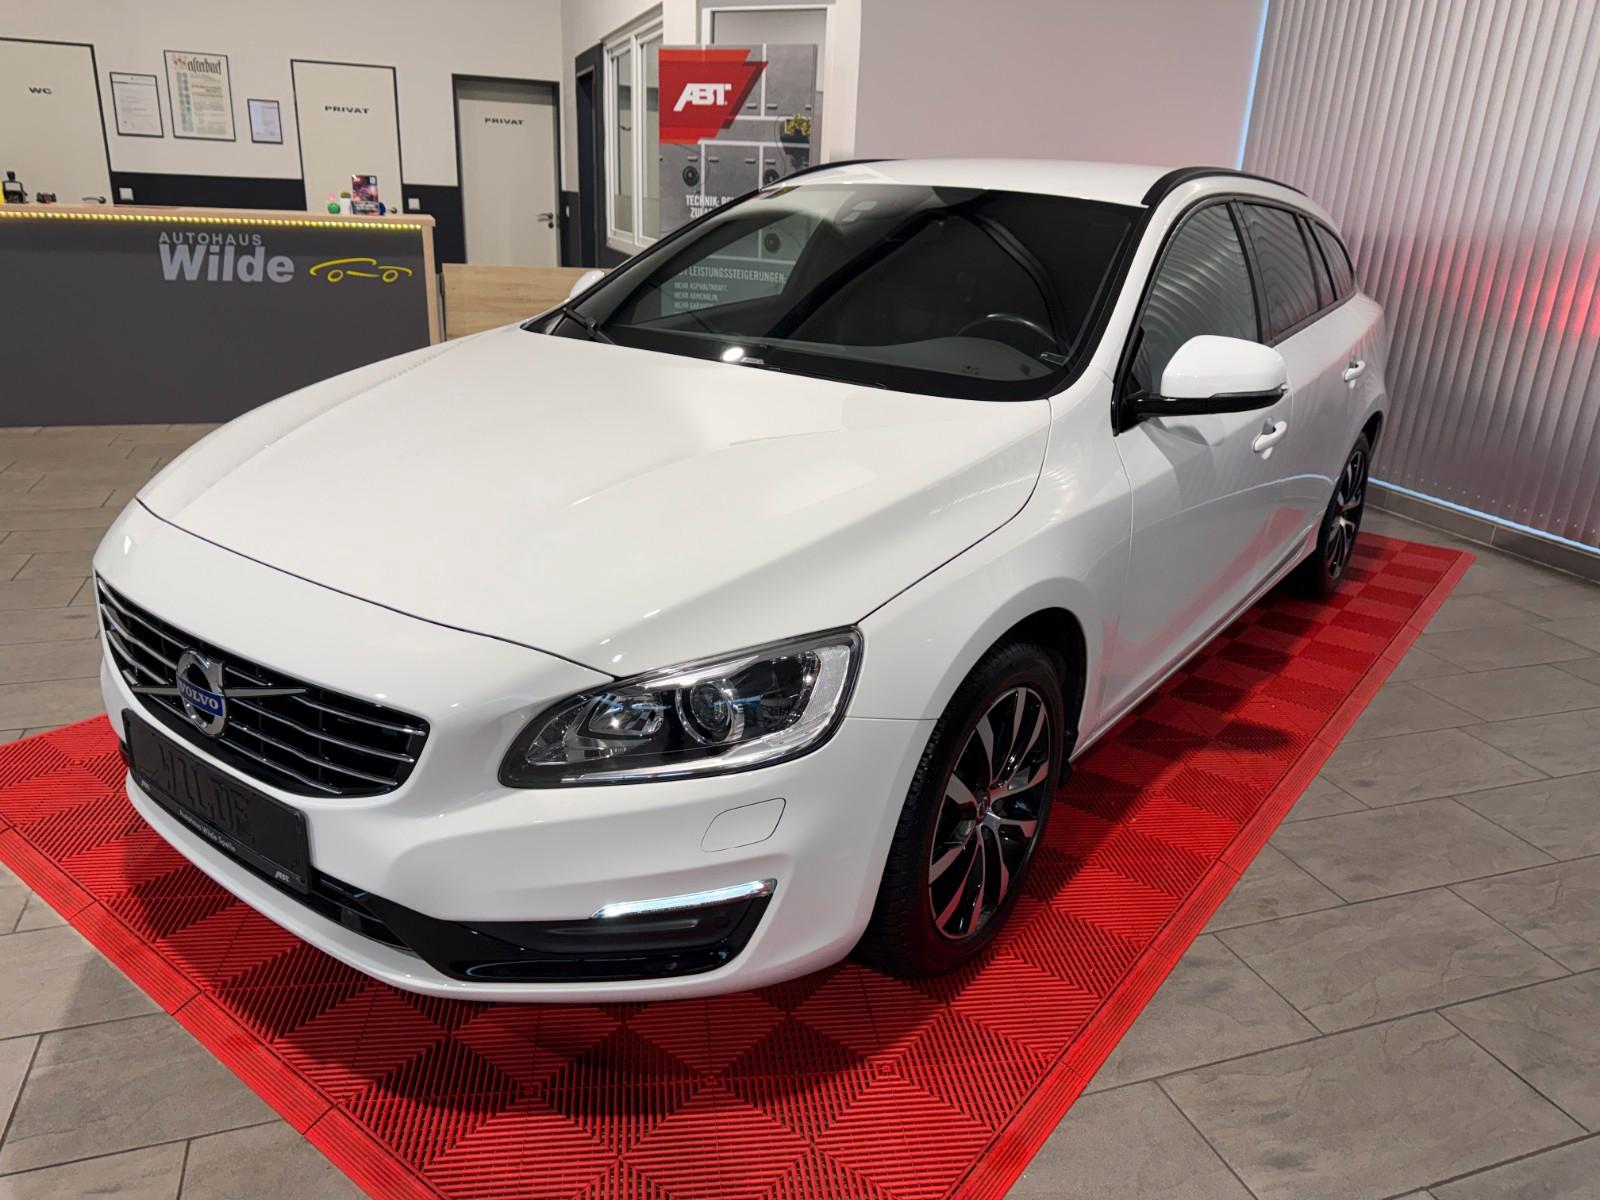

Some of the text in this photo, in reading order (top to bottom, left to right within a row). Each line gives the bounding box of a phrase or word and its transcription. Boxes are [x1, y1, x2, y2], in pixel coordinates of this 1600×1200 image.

[29, 87, 52, 95] WC
[324, 105, 369, 114] PRIVAT
[484, 117, 524, 125] PRIVAT
[685, 194, 720, 207] TECHNIK:
[159, 232, 262, 246] AUTOHAUS
[159, 244, 295, 283] Wilde
[180, 681, 219, 710] VOLVO
